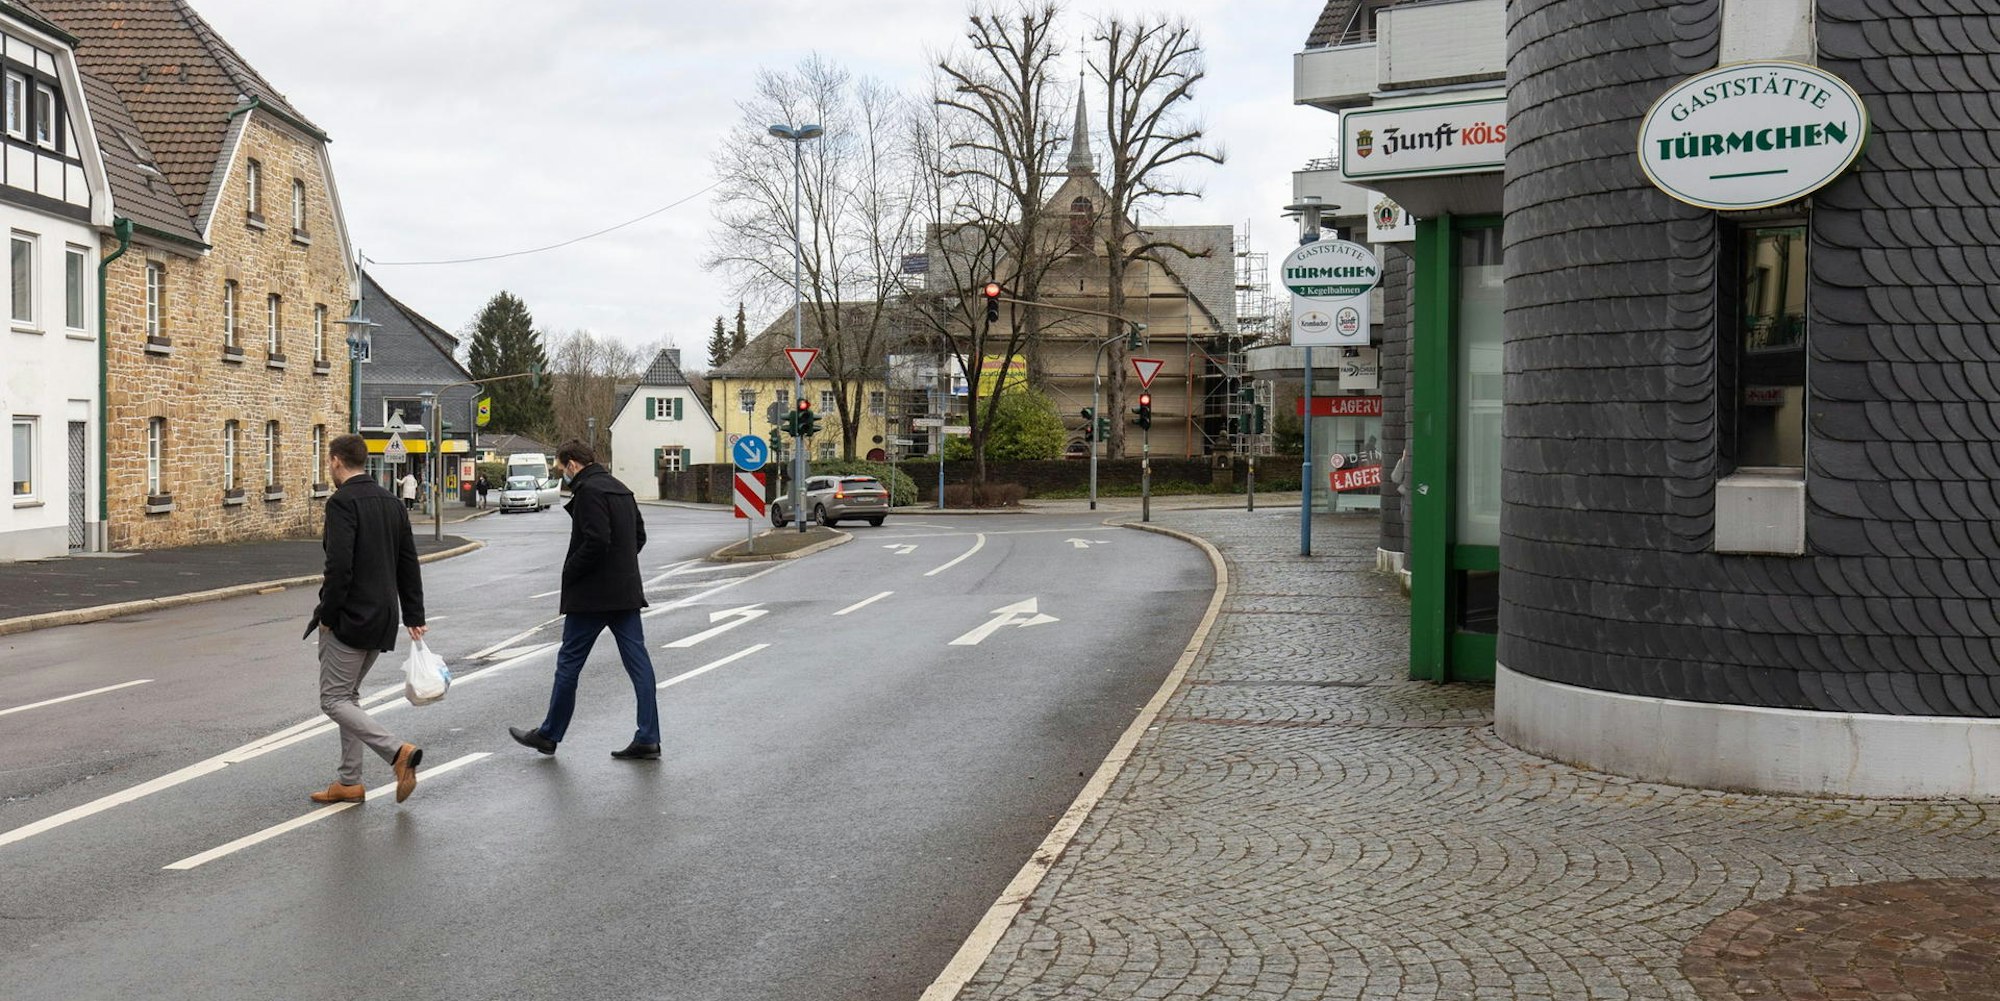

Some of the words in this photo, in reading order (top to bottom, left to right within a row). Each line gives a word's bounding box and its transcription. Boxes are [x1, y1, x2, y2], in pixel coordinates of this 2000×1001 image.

[1671, 72, 1832, 122] GASTSTÄTTE
[1381, 122, 1459, 157] Zunft
[1656, 120, 1848, 161] TÜRMCHEN
[1297, 244, 1365, 261] GASTSTÄTTE
[1286, 265, 1376, 279] TÜRMCHEN
[1300, 286, 1305, 295] 2
[1307, 286, 1360, 296] Kegelbahnen
[1350, 450, 1382, 464] DEIN
